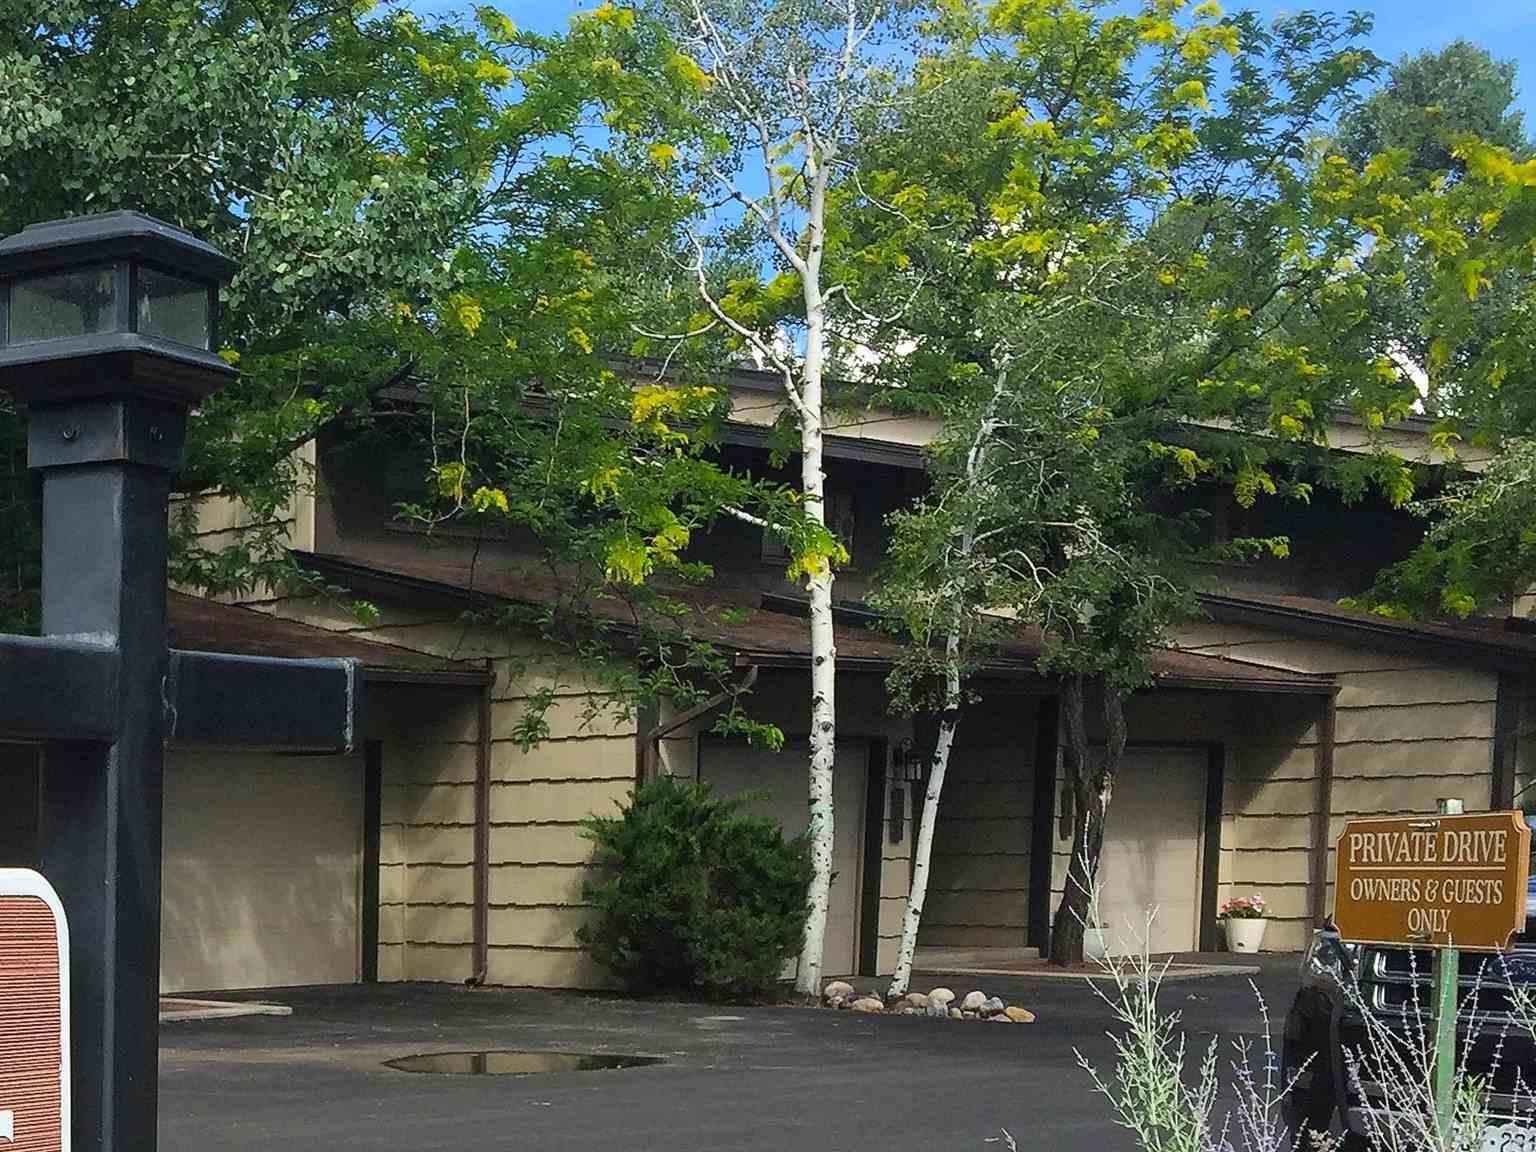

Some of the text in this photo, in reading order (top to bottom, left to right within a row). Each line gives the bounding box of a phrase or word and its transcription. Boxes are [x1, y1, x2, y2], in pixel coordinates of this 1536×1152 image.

[1349, 830, 1507, 863] PRIVATE DRIVE
[1350, 878, 1504, 905] OWNERS & GUESTS
[1407, 908, 1451, 933] ONLY
